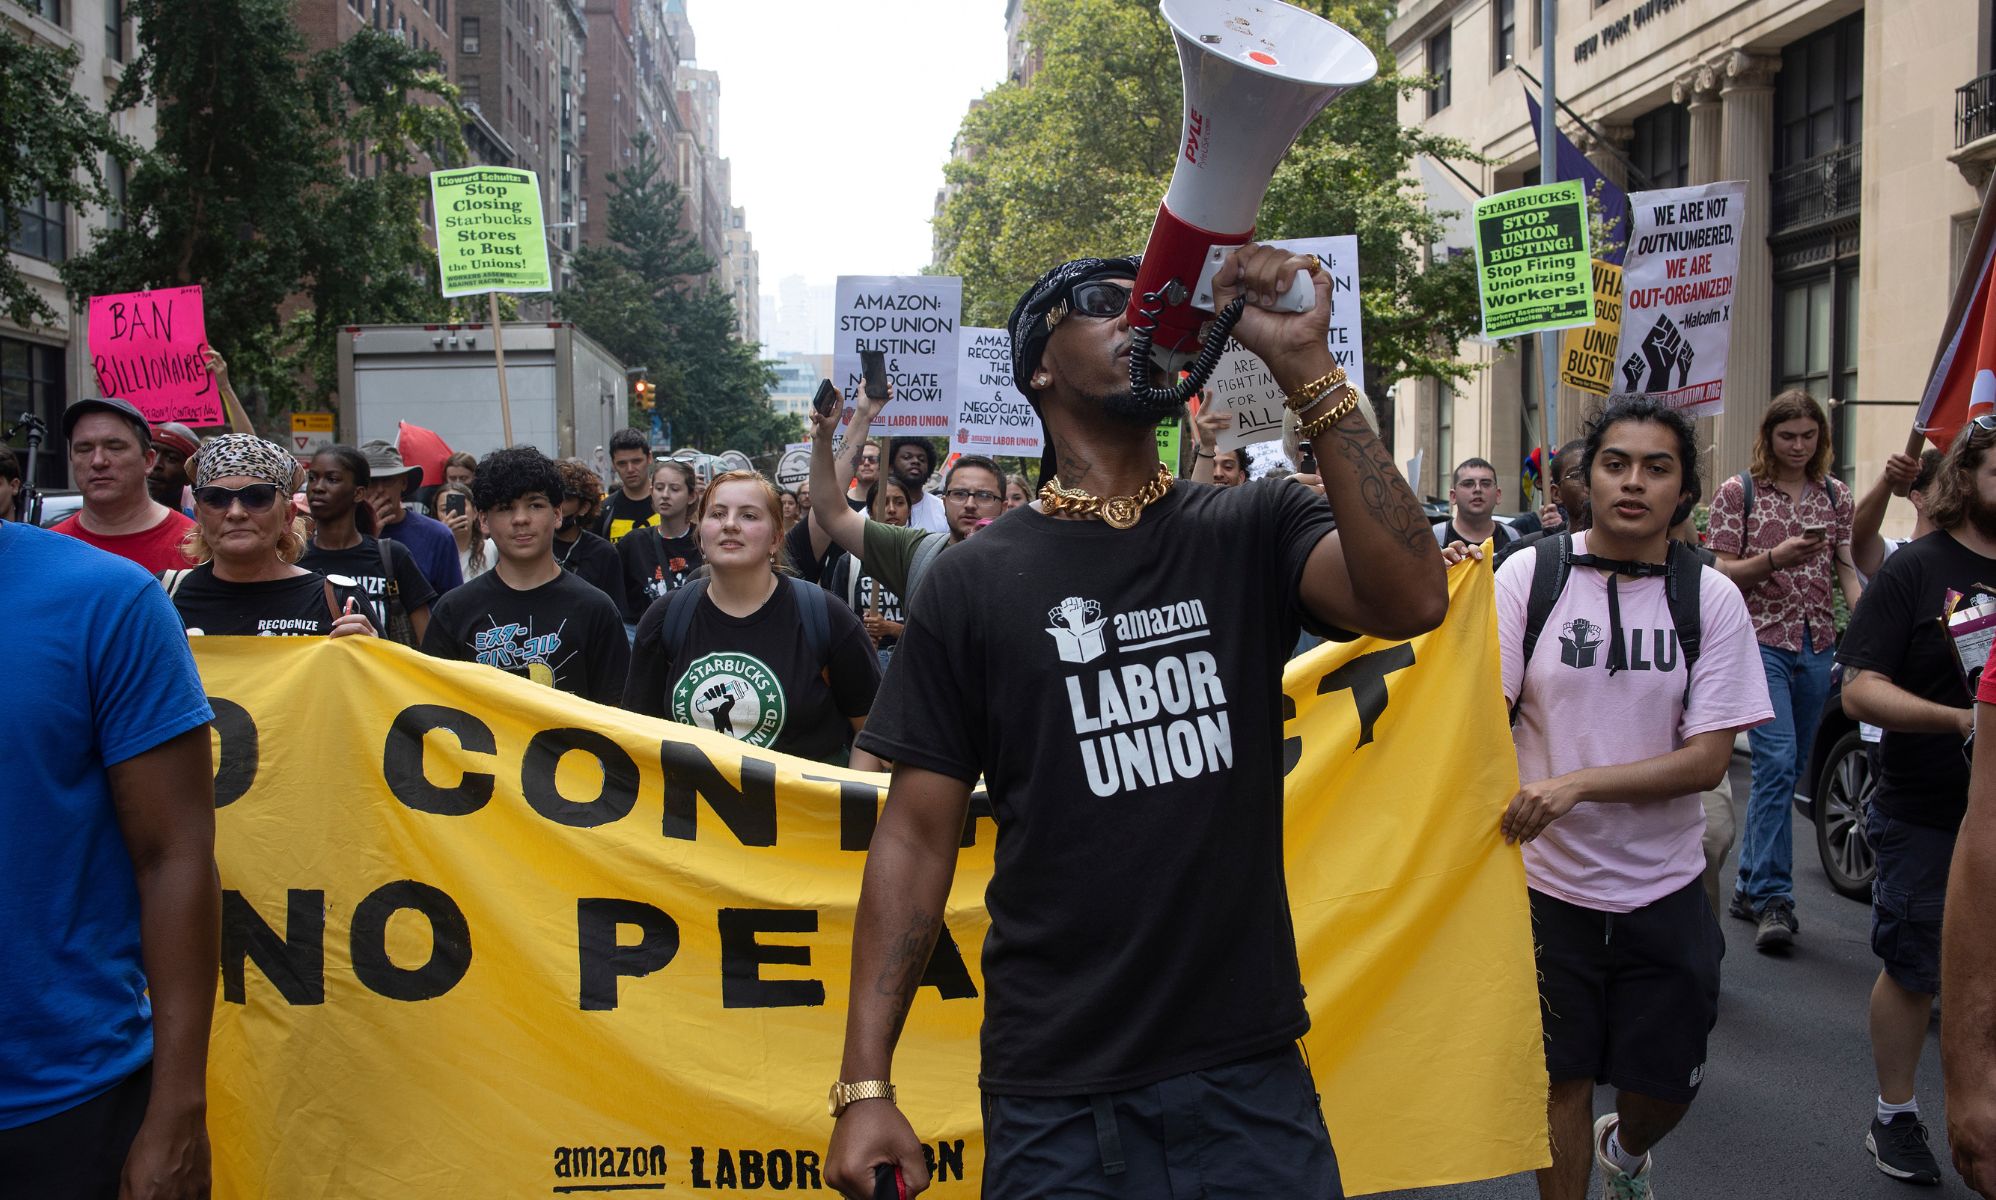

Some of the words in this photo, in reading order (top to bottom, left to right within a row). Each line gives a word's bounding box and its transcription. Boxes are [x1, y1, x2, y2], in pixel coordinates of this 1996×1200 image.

[1574, 34, 1598, 64] NEW
[1601, 14, 1630, 48] YORK
[1185, 105, 1203, 165] PYLE
[441, 173, 478, 185] Howard
[465, 184, 507, 198] Stop
[453, 199, 522, 213] Closing
[1478, 190, 1576, 217] STARBUCKS:
[1654, 204, 1675, 226] WE
[1680, 200, 1703, 223] ARE
[1707, 197, 1728, 219] NOT
[445, 213, 532, 227] Starbucks
[1503, 210, 1549, 230] STOP
[457, 230, 516, 242] Stores
[1501, 224, 1559, 245] UNION
[1638, 224, 1734, 255] OUTNUMBERED,
[459, 247, 475, 256] to
[480, 243, 522, 255] Bust
[1490, 237, 1574, 263] BUSTING!
[448, 263, 467, 272] the
[471, 259, 526, 270] Unions!
[1487, 263, 1522, 279] Stop
[1527, 257, 1576, 271] Firing
[1666, 257, 1688, 279] WE
[1690, 253, 1712, 275] ARE
[1489, 271, 1576, 292] Unionizing
[1486, 282, 1585, 309] Workers!
[1629, 275, 1732, 309] OUT-ORGANIZED!
[854, 294, 941, 311] AMAZON:
[109, 300, 172, 342] BAN
[1486, 312, 1516, 322] Workers
[1517, 306, 1554, 316] Assembly
[1487, 318, 1514, 329] Against
[1516, 313, 1543, 323] Racism
[1722, 305, 1730, 321] X
[841, 316, 886, 332] STOP
[891, 317, 953, 333] UNION
[856, 338, 936, 355] BUSTING!
[975, 336, 1011, 348] AMAZ
[92, 343, 211, 398] BILLIONAIRES
[889, 359, 899, 371] &
[990, 362, 1010, 373] THE
[1234, 358, 1258, 374] ARE
[1217, 372, 1273, 393] FIGHTIN
[897, 388, 942, 402] NOW!
[995, 391, 1002, 401] &
[1227, 393, 1257, 408] FOR
[1266, 388, 1285, 399] US
[964, 401, 1031, 415] NEGOCIATE
[888, 416, 917, 426] LABOR
[920, 416, 948, 427] UNION
[960, 413, 997, 425] FAIRLY
[1000, 415, 1034, 427] NOW!
[1239, 408, 1282, 429] ALL
[993, 436, 1015, 446] LABOR
[1016, 438, 1038, 447] UNION
[257, 619, 319, 631] RECOGNIZE
[1113, 598, 1208, 641] amazon
[476, 623, 527, 650] ミスター
[1605, 628, 1677, 672] ALU
[689, 659, 770, 691] STARBUCKS
[1065, 650, 1227, 734] LABOR
[1080, 710, 1233, 797] UNION
[221, 879, 472, 1005] NO
[554, 1144, 667, 1178] amazon
[689, 1145, 824, 1190] LABOR
